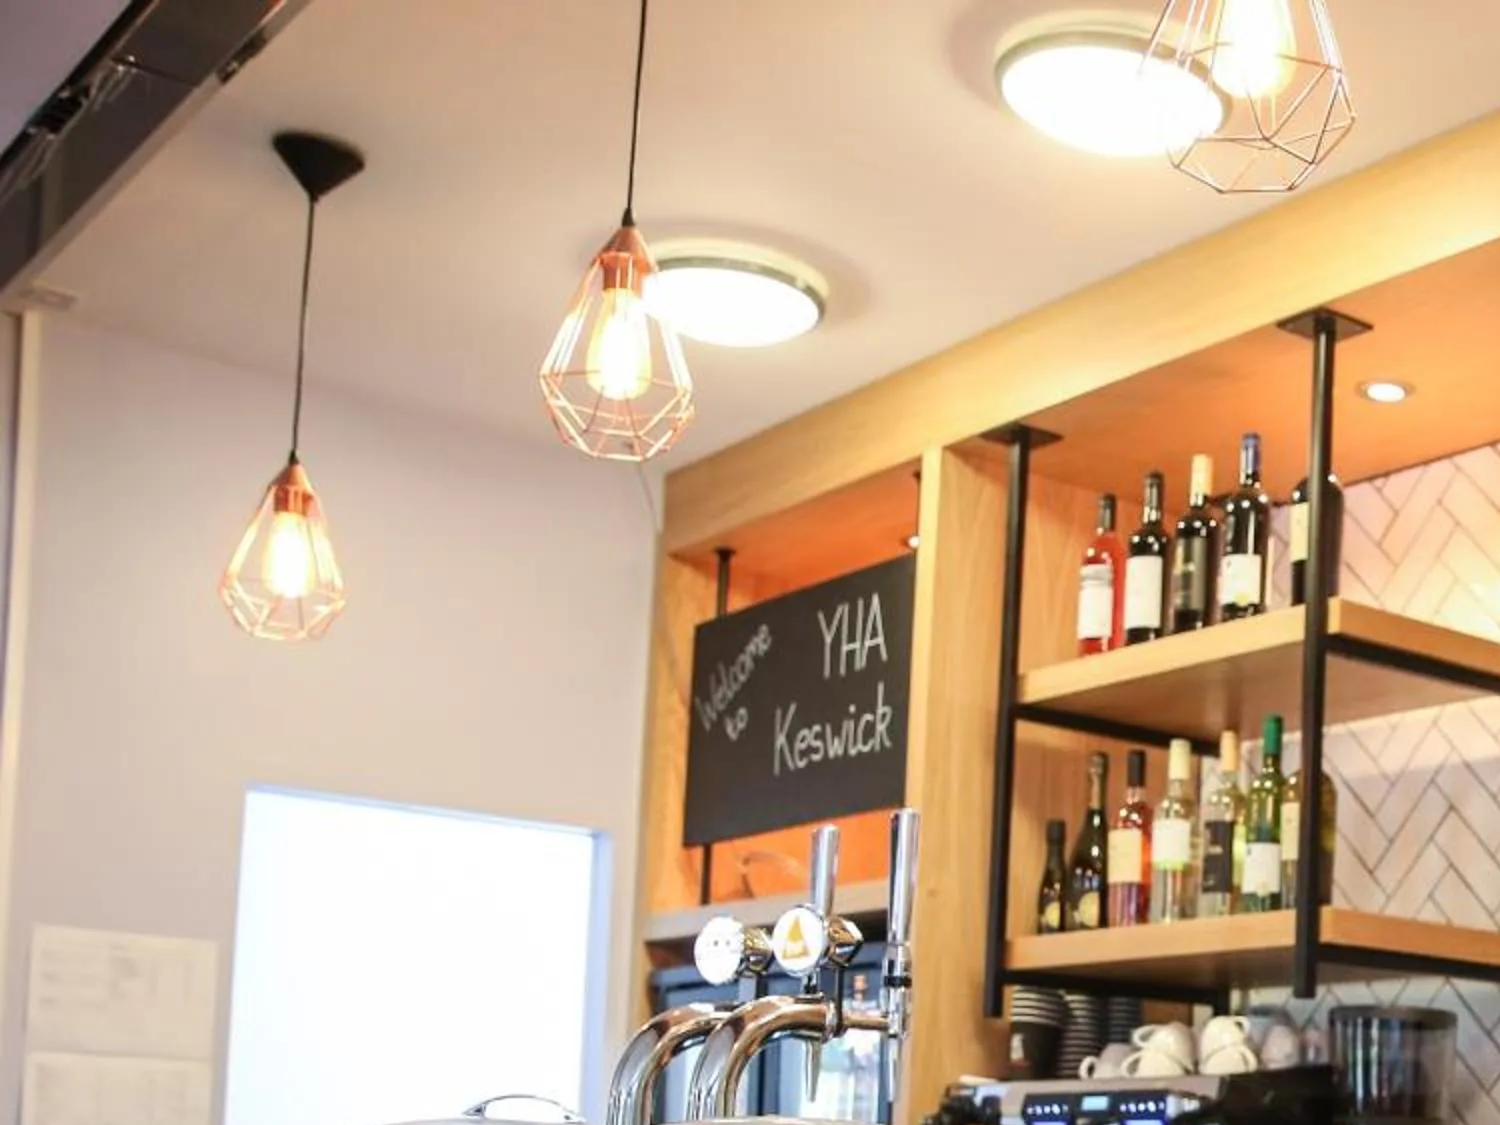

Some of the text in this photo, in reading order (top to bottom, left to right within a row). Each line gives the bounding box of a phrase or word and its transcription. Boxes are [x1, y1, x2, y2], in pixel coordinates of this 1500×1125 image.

[694, 622, 773, 733] Welcome
[817, 592, 888, 680] YHA
[772, 680, 893, 778] Keswick
